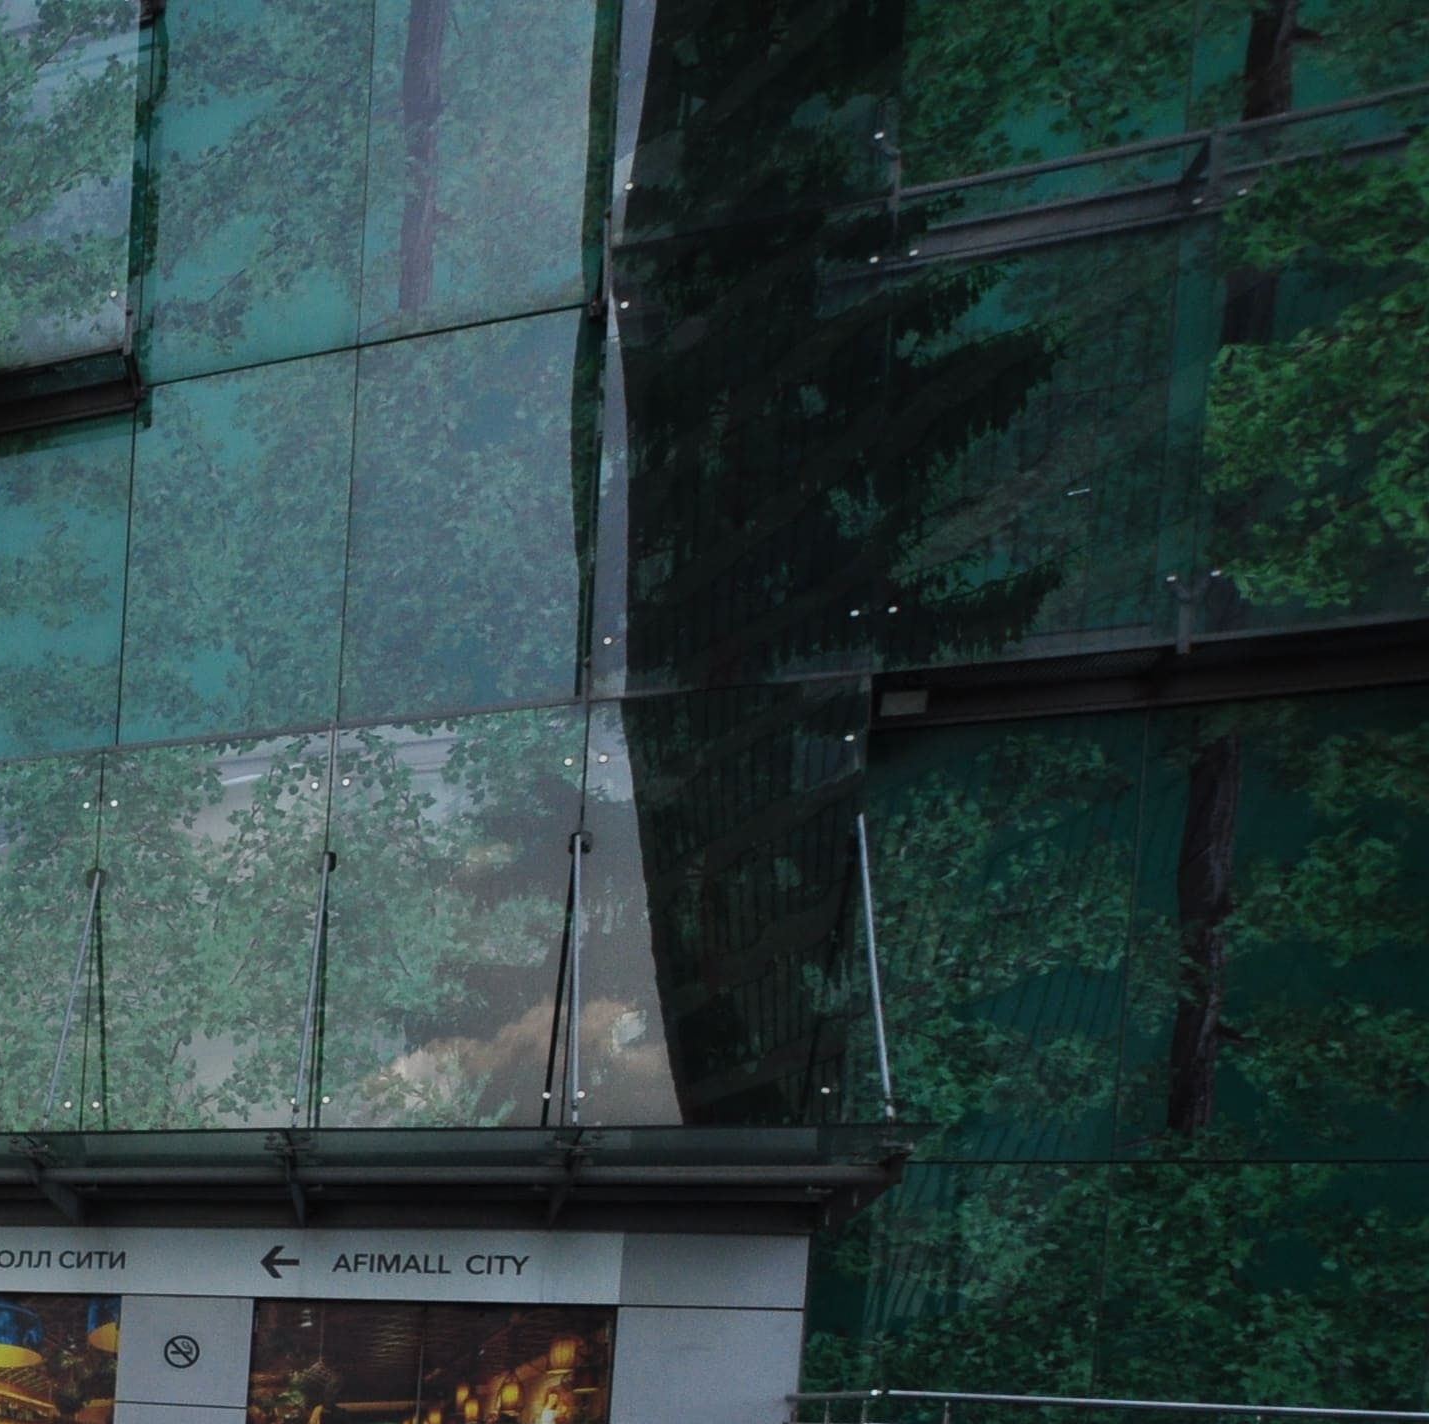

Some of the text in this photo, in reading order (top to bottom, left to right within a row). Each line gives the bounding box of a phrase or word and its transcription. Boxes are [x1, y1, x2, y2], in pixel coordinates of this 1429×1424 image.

[58, 1250, 127, 1269] СИТИ
[331, 1253, 530, 1276] AFIMALL CITY
